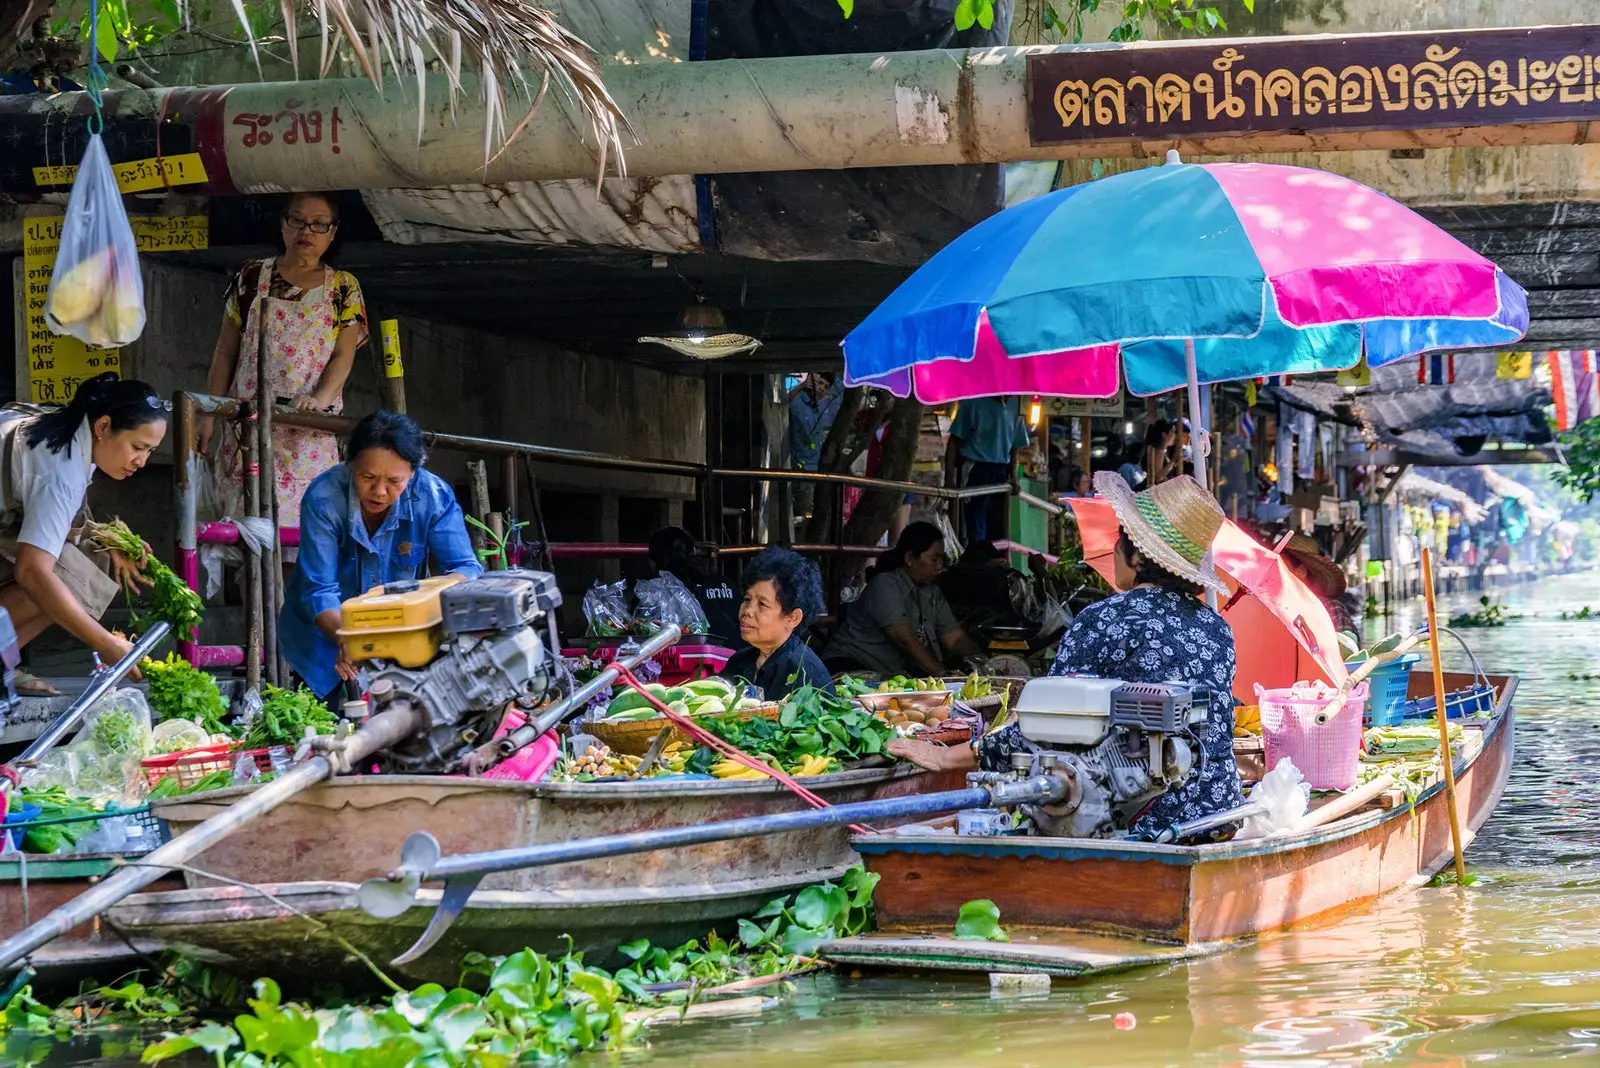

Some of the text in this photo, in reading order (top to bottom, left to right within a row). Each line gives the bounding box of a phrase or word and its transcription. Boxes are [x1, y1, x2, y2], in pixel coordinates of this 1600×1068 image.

[1054, 44, 1600, 128] ตลาดน้ำคลองลัดมะย
